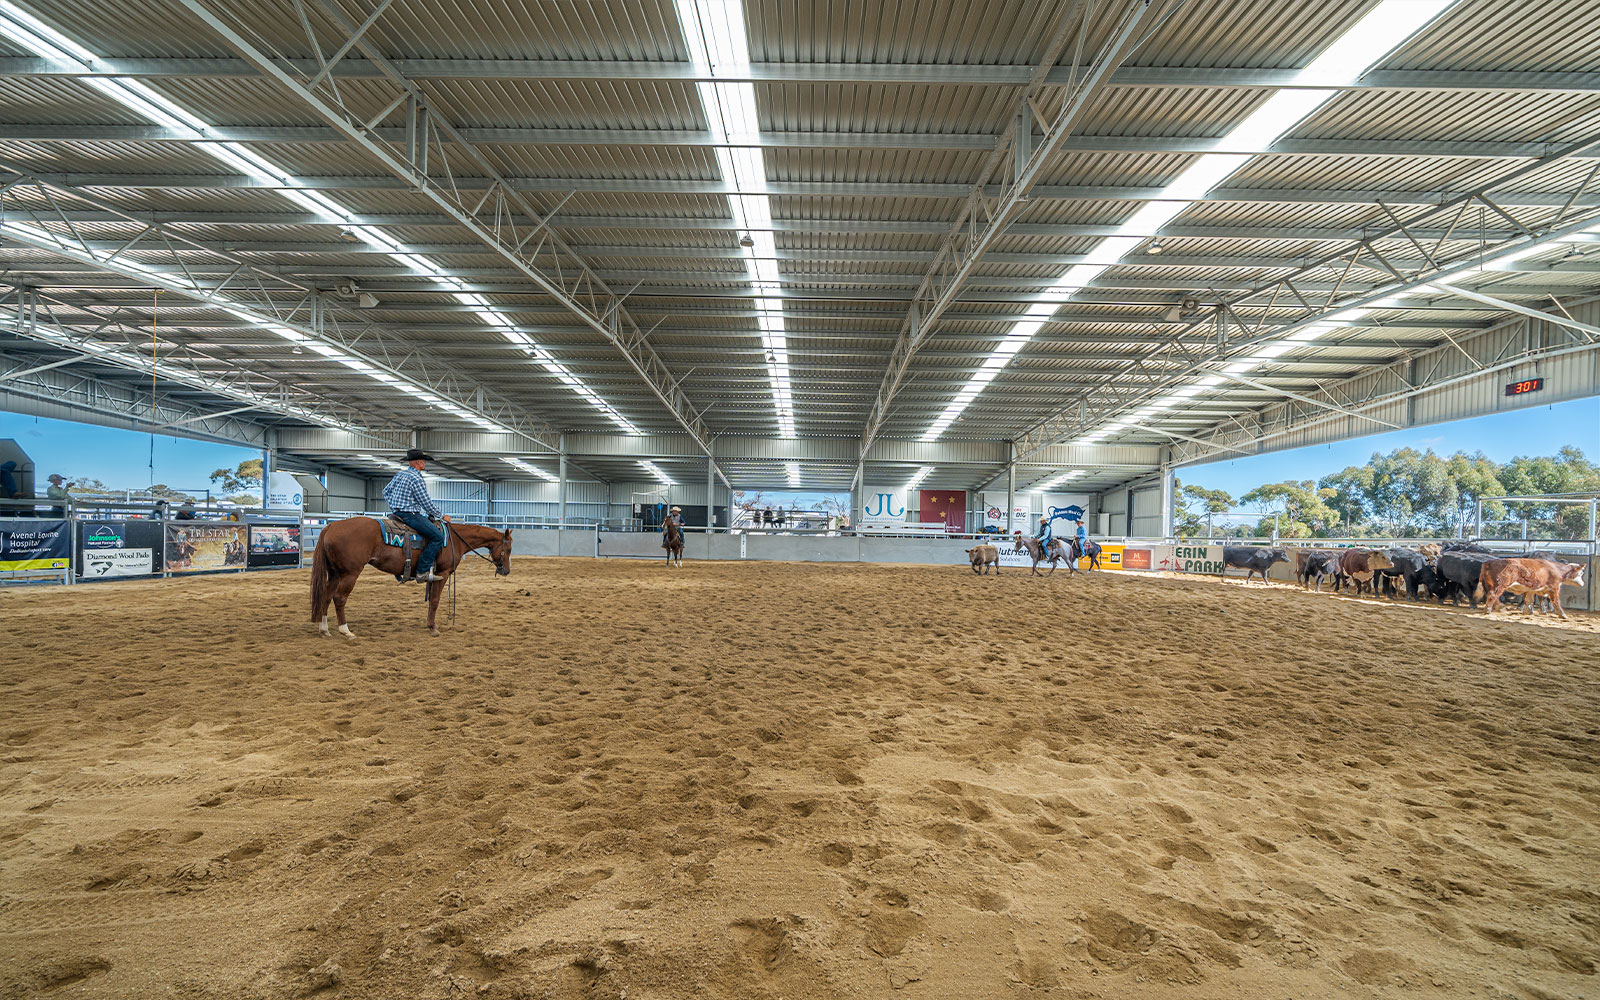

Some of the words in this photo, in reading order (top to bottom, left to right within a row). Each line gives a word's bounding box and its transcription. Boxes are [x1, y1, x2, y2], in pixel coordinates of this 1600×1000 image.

[1515, 380, 1537, 394] 301
[10, 531, 36, 539] Avenel
[190, 528, 205, 538] TRI
[208, 528, 230, 538] STAR
[10, 540, 40, 548] Hospital
[1175, 547, 1208, 559] ERIN
[1185, 560, 1223, 573] PARK
